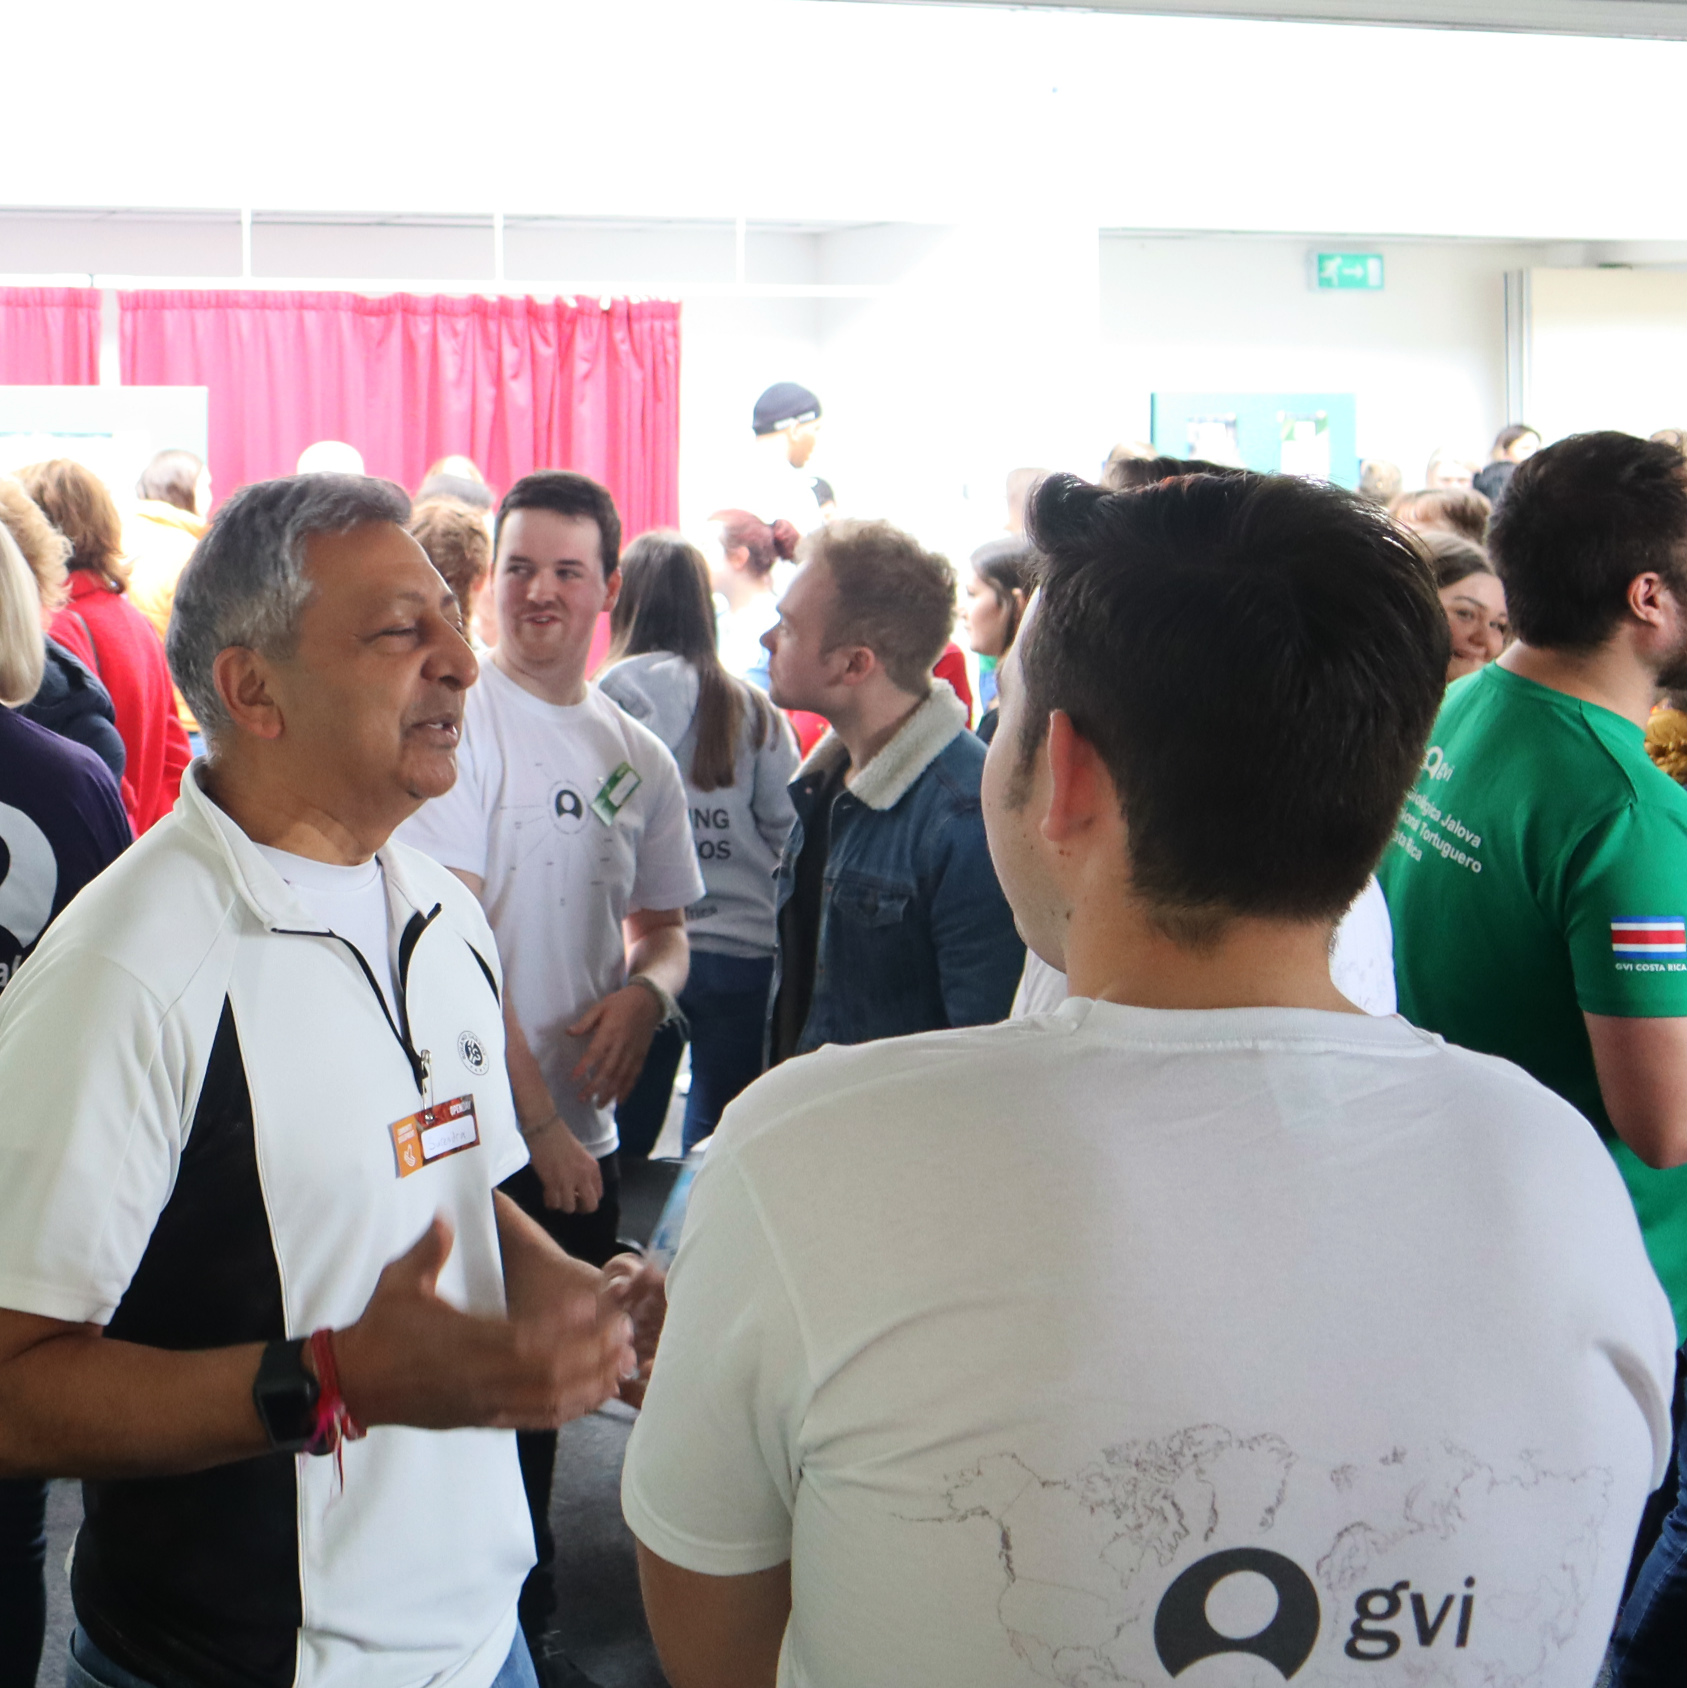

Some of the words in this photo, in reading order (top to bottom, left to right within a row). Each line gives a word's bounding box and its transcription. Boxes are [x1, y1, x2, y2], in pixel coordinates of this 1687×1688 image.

[1419, 821, 1482, 873] Tortuguero
[1440, 814, 1482, 849] Jalova
[1615, 963, 1633, 971] GVI
[1636, 963, 1666, 972] COSTA
[1668, 963, 1687, 972] RICA
[1344, 1575, 1476, 1661] gvi
